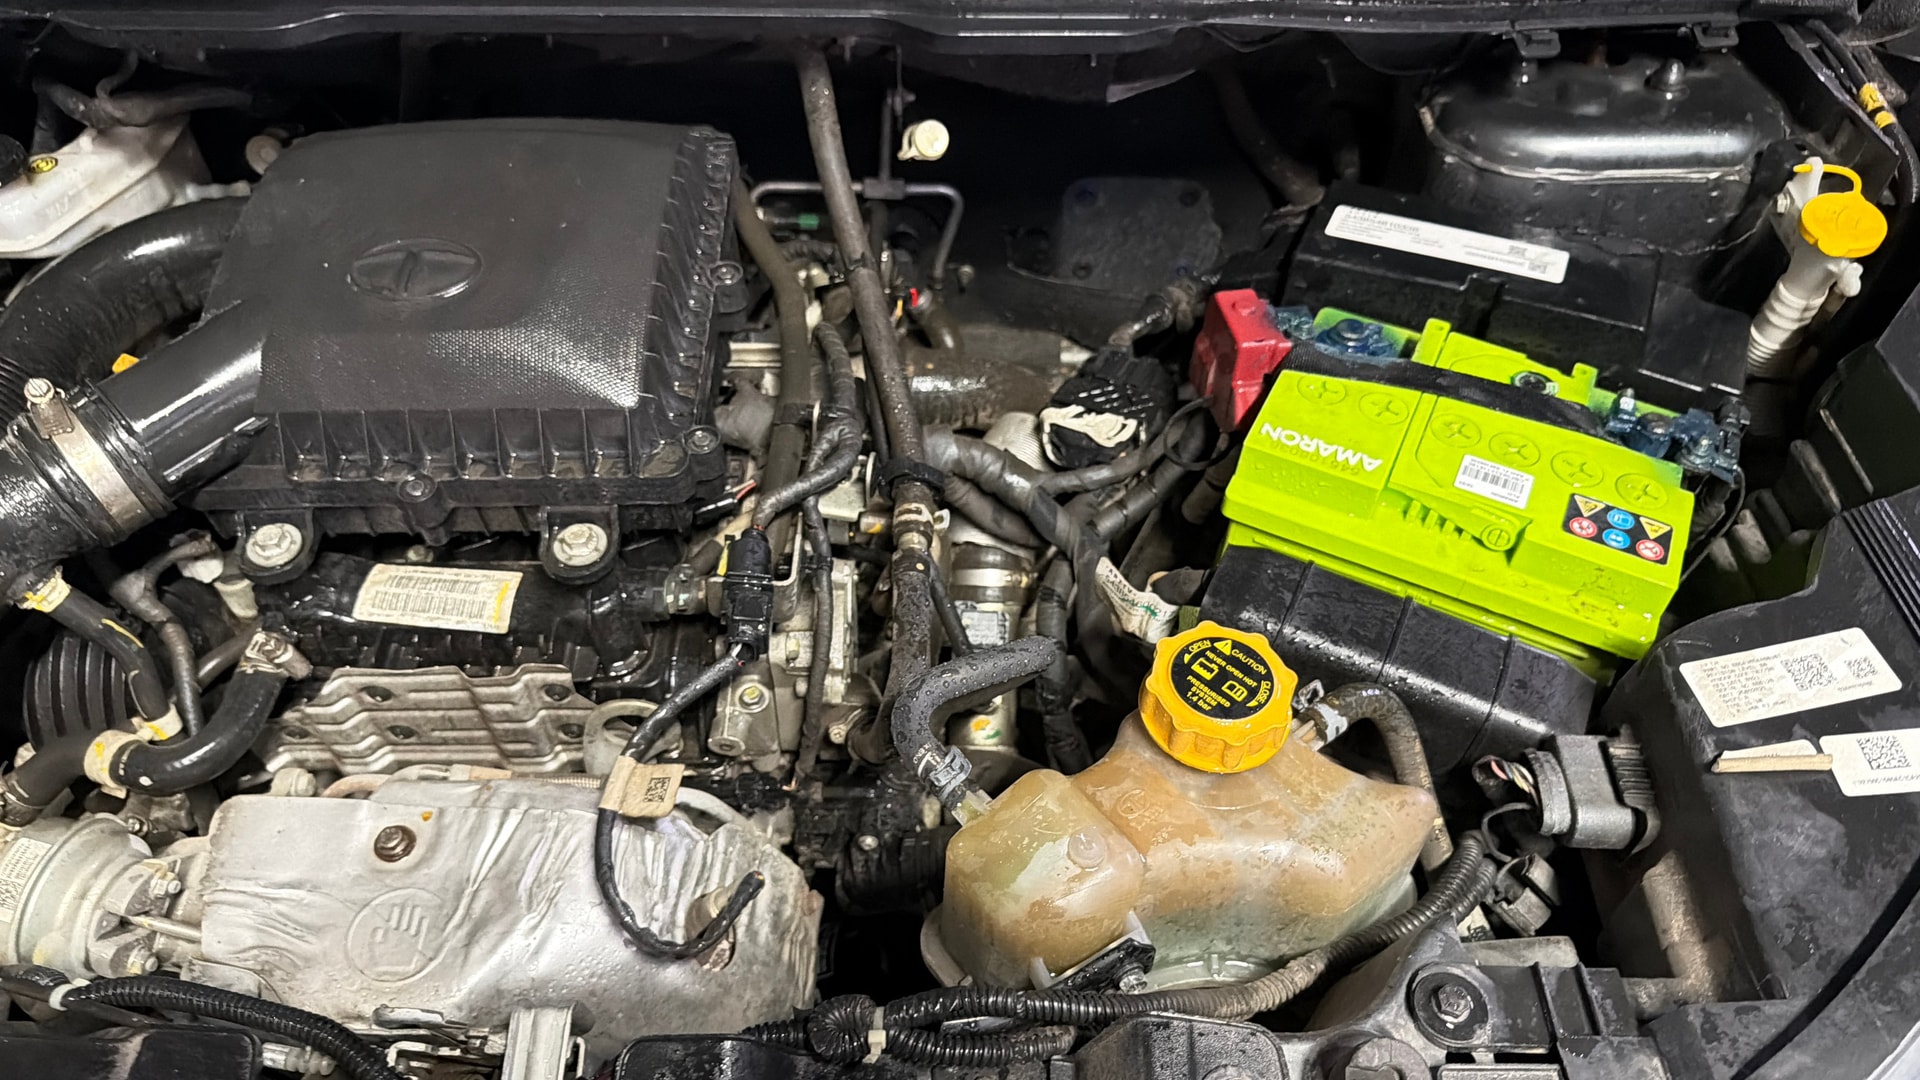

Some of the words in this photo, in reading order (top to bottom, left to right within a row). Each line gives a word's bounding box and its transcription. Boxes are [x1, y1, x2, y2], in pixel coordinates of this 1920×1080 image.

[1261, 423, 1383, 472] AMARON
[1188, 640, 1212, 652] OPEN
[1205, 650, 1227, 668] NEVER
[1225, 664, 1244, 680] OPEN
[1242, 675, 1258, 688] HOT
[1232, 649, 1267, 675] CAUTION
[1186, 691, 1199, 702] 1.4
[1198, 698, 1212, 711] bar
[1187, 675, 1231, 707] PRESSURISED
[1191, 686, 1218, 706] SYSTEM
[1258, 681, 1271, 704] CLOSE
